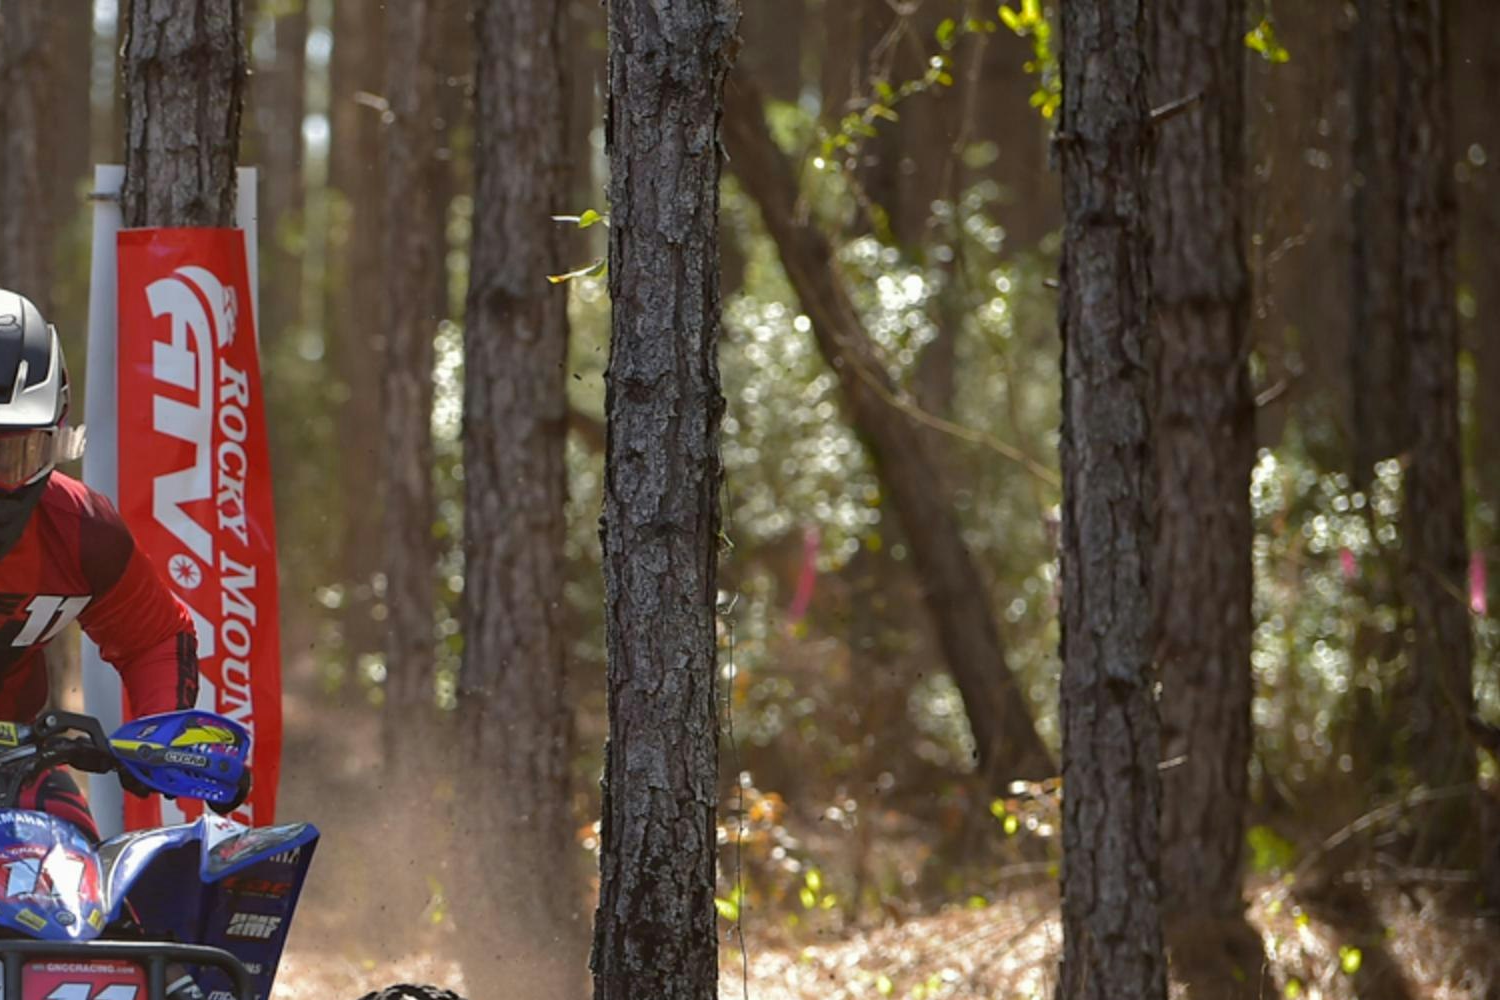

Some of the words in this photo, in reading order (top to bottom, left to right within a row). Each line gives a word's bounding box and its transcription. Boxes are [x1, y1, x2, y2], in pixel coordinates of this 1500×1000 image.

[216, 357, 250, 547] ROCKY
[11, 595, 93, 647] 11
[165, 751, 207, 767] CYCRA
